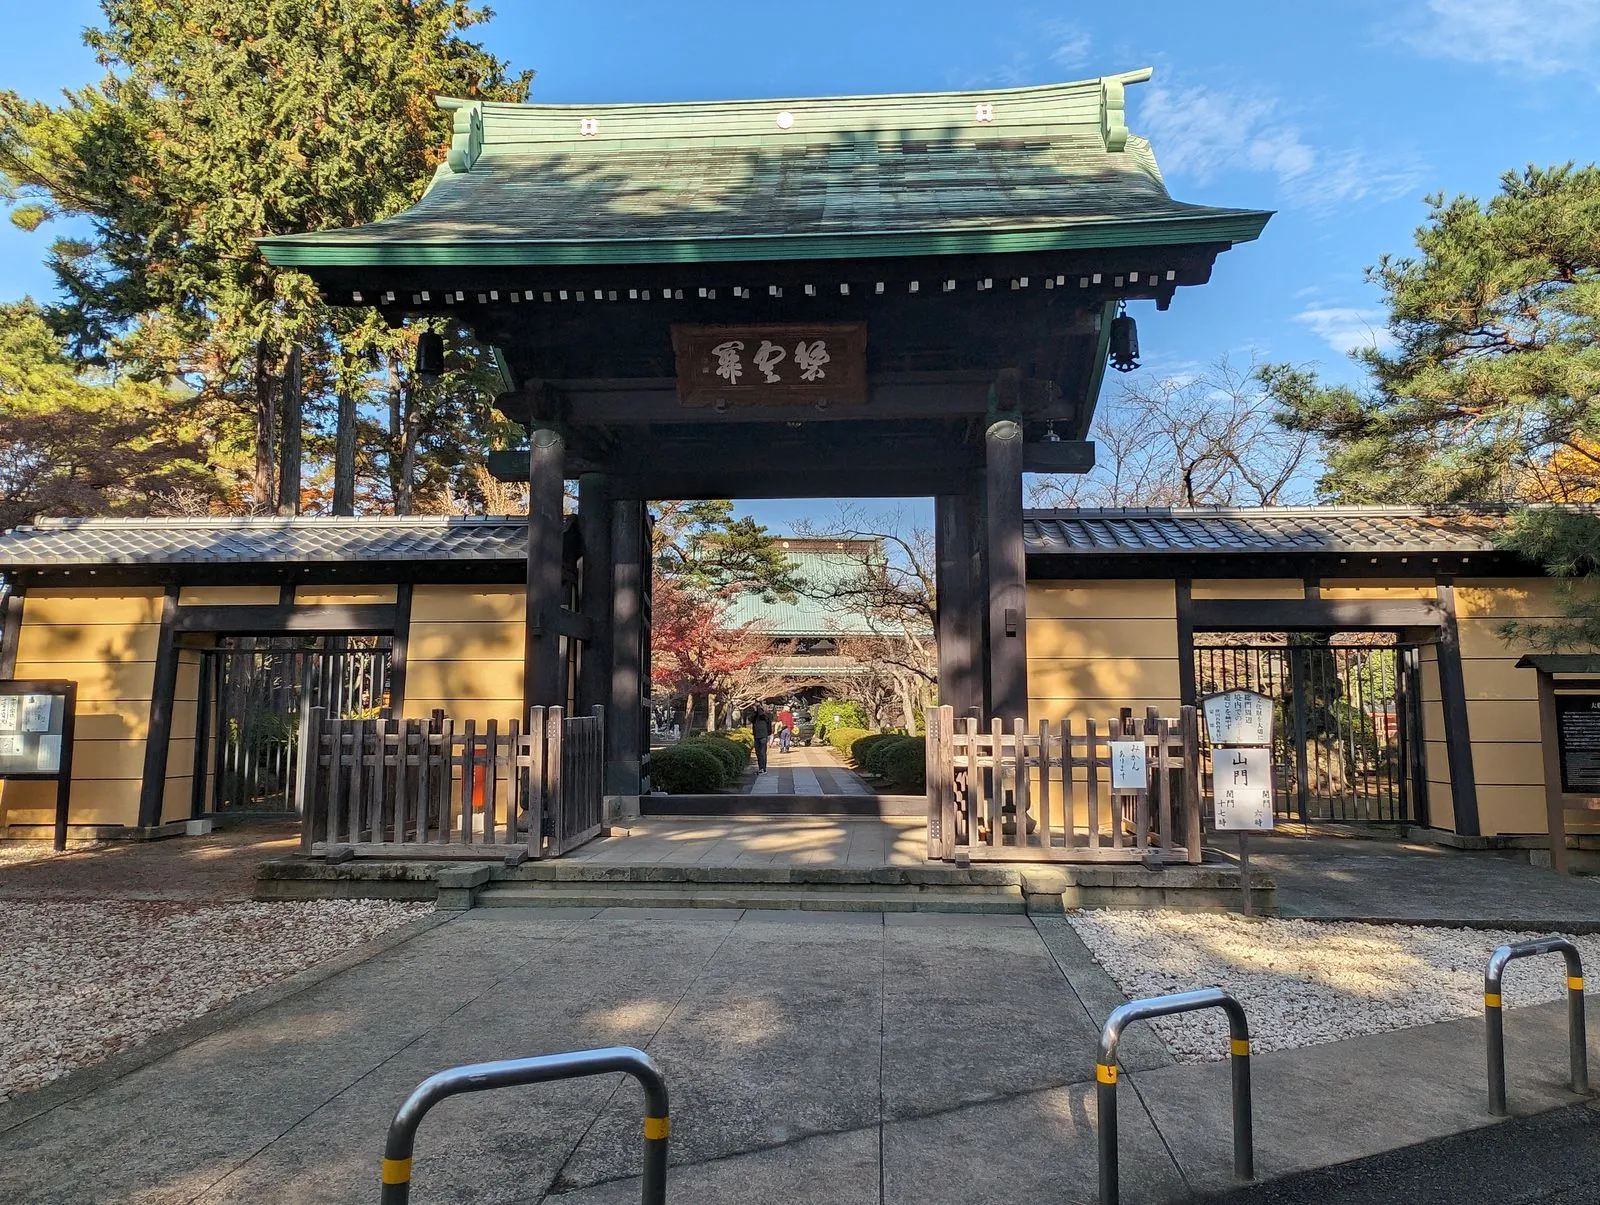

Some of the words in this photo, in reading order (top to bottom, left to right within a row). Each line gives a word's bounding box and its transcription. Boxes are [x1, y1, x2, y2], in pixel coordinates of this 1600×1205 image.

[1131, 744, 1141, 771] みかん
[1233, 752, 1248, 786] 山門
[1217, 799, 1227, 827] 十七時
[1254, 809, 1263, 827] 六時
